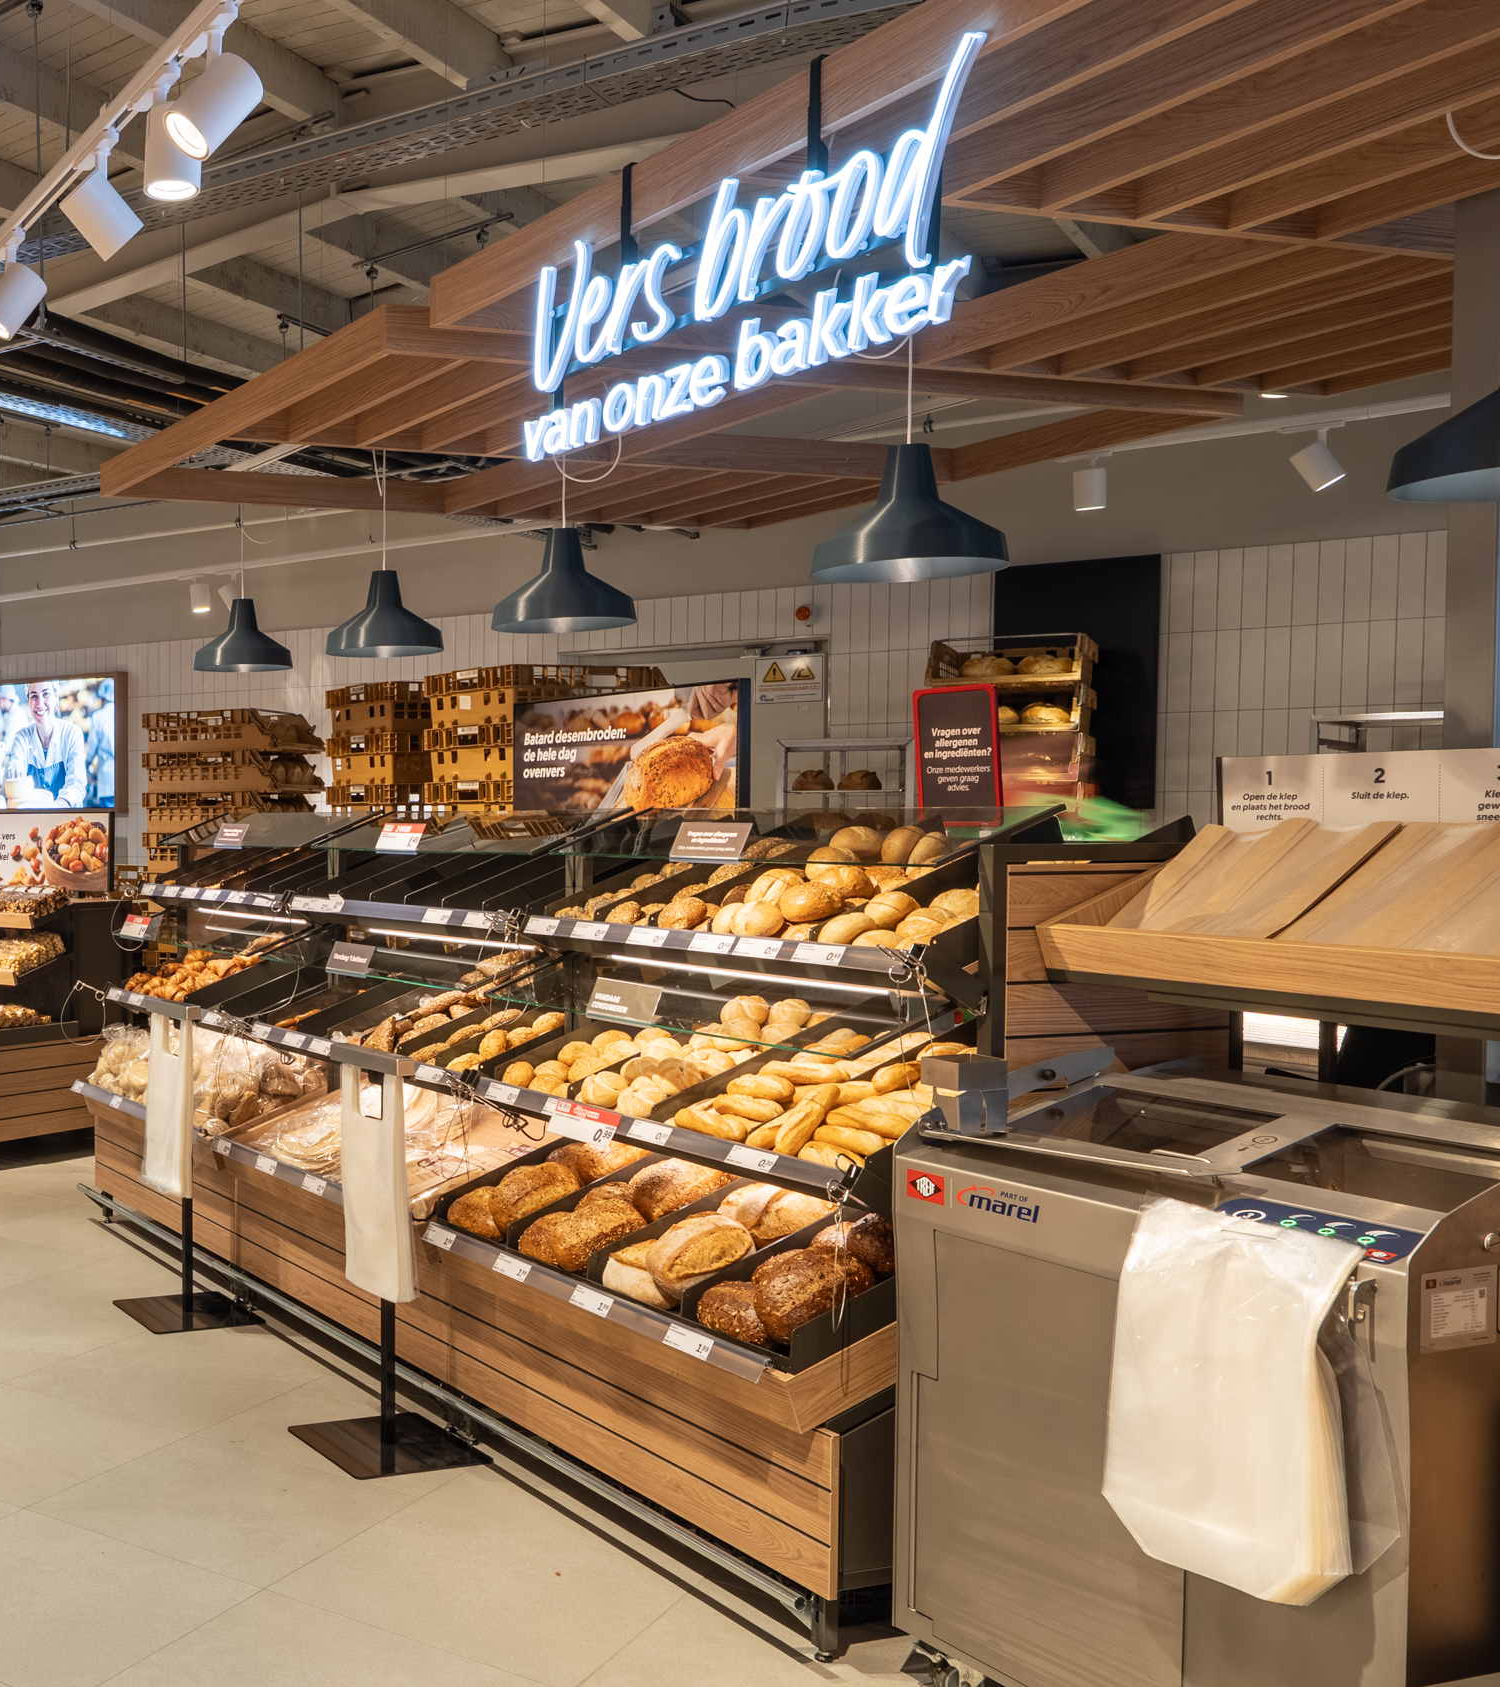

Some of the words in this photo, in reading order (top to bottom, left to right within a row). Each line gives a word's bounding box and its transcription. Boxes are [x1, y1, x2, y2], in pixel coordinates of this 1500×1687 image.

[534, 240, 682, 393] Vers
[694, 31, 988, 322] brood
[524, 405, 600, 462] van
[603, 355, 730, 432] onze
[734, 255, 972, 390] bakker
[523, 730, 554, 746] Batard
[555, 726, 627, 744] desembroden:
[931, 727, 960, 738] Vragen
[962, 727, 981, 735] over
[935, 738, 978, 748] allergenen
[523, 748, 536, 762] de
[536, 747, 557, 762] hele
[558, 746, 577, 763] dag
[934, 747, 992, 760] ingrediënten?
[522, 766, 565, 779] ovenvers
[927, 766, 944, 774] Onze
[945, 765, 990, 773] medewerkers
[937, 776, 958, 784] geven
[959, 775, 979, 783] graag
[1266, 771, 1273, 786] 1
[1373, 767, 1385, 784] 2
[1243, 793, 1264, 802] Open
[1266, 793, 1277, 801] de
[1279, 792, 1297, 802] klep
[1351, 791, 1371, 800] Sluit
[1372, 791, 1384, 799] de
[1386, 790, 1409, 801] klep.
[1231, 803, 1241, 811] en
[1243, 802, 1267, 812] plaats
[1269, 803, 1282, 811] het
[1284, 802, 1310, 811] brood
[1256, 813, 1283, 821] rechts.
[0, 842, 6, 850] in
[826, 952, 842, 961] 0.49
[595, 992, 621, 1003] VANDAAG
[591, 1001, 628, 1014] CONSUMEREN
[593, 1128, 612, 1143] 0.99
[758, 1159, 773, 1168] 0.30
[916, 1176, 936, 1198] TREIF
[1000, 1191, 1018, 1202] PART
[1018, 1195, 1028, 1203] OF
[968, 1194, 1040, 1223] marel
[696, 1344, 709, 1353] 1.99
